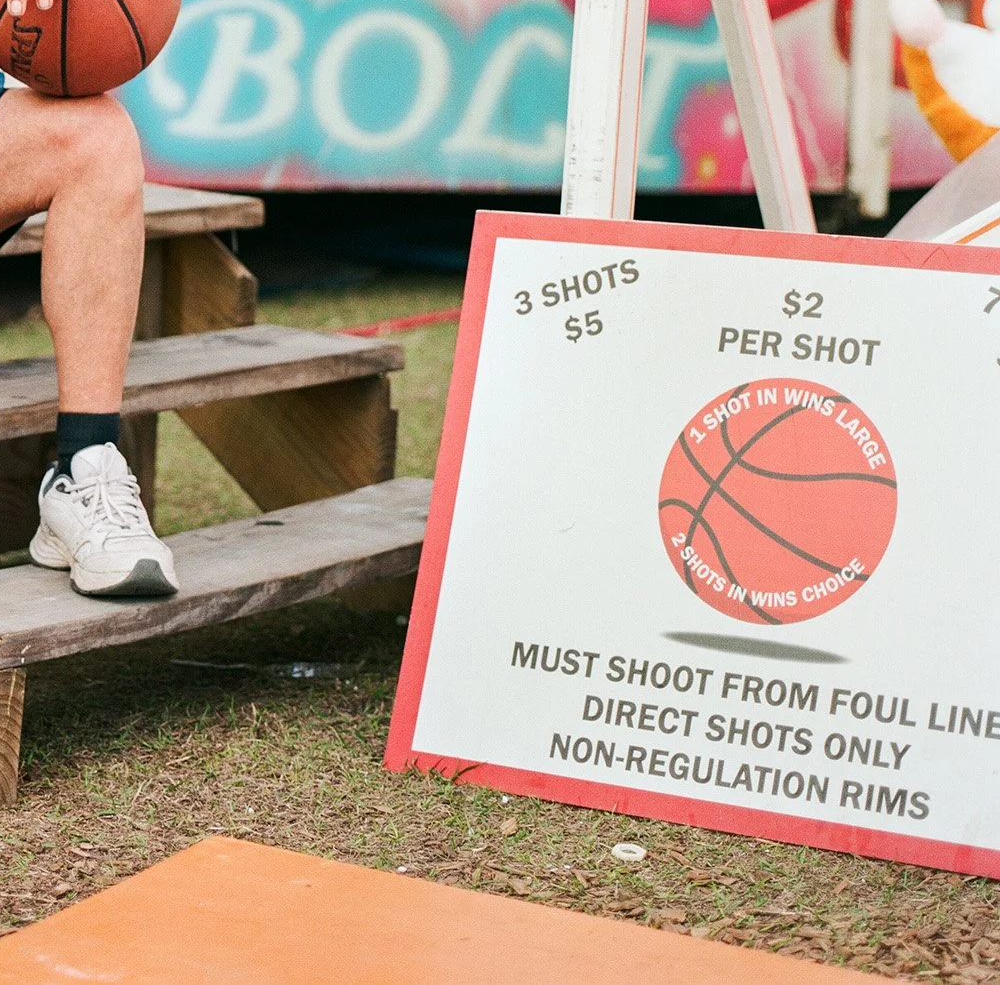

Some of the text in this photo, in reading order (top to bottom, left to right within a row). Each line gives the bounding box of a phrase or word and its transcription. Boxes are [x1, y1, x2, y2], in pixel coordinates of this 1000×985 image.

[514, 258, 640, 316] 3 SHOTS
[781, 288, 824, 319] $2
[564, 309, 604, 344] $5
[718, 326, 881, 366] PER SHOT
[690, 388, 887, 470] 1 SHOT IN WINS LARGE
[670, 532, 866, 608] 2 SHOTS IN WINS CHOICE
[510, 641, 1000, 740] MUST SHOOT FROM FOUL LINE
[582, 694, 912, 771] DIRECT SHOTS ONLY
[549, 732, 931, 821] NON-REGULATION RIMS
